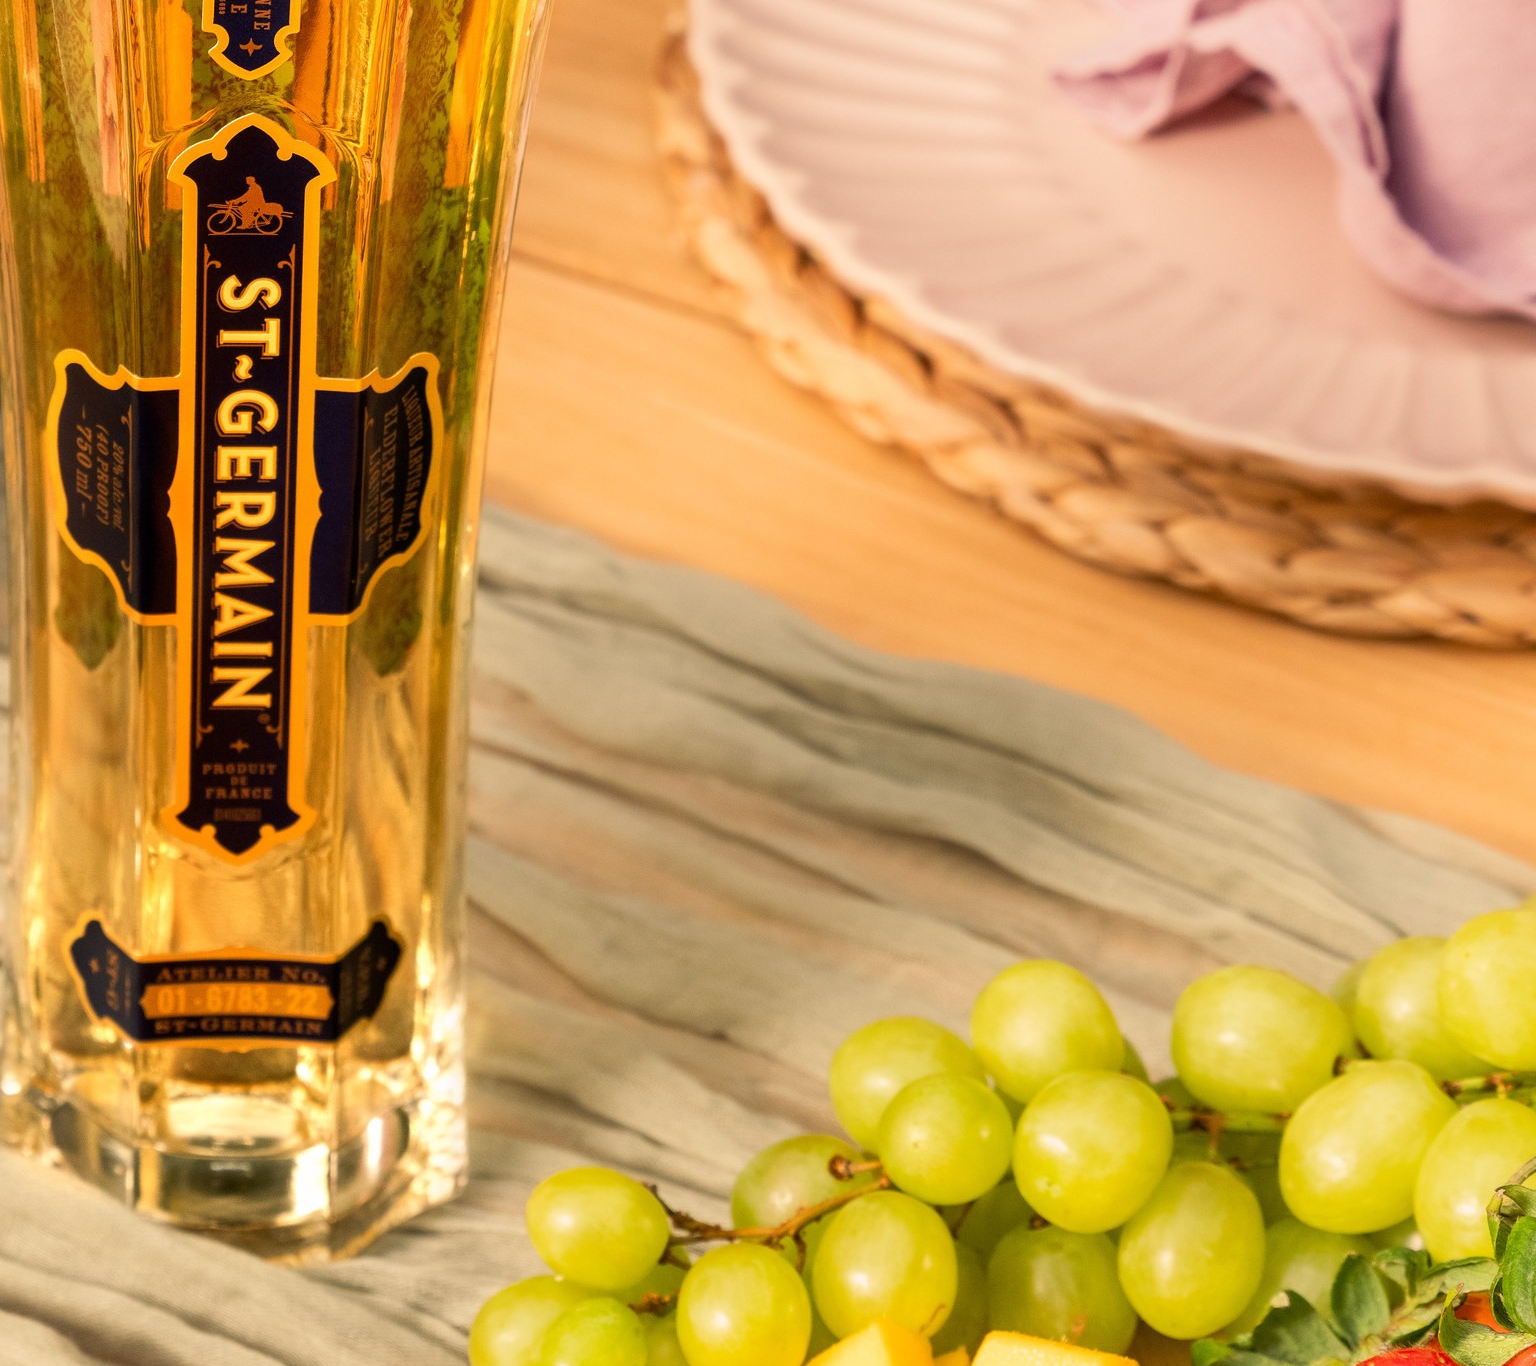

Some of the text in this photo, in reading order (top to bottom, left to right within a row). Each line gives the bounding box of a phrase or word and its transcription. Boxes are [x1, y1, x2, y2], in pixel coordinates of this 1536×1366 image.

[76, 424, 93, 502] 750 ml
[377, 404, 399, 558] ELDERFLOWER
[202, 762, 278, 775] PRODUIT
[205, 787, 273, 800] FRANCE
[156, 966, 271, 982] ATELIER
